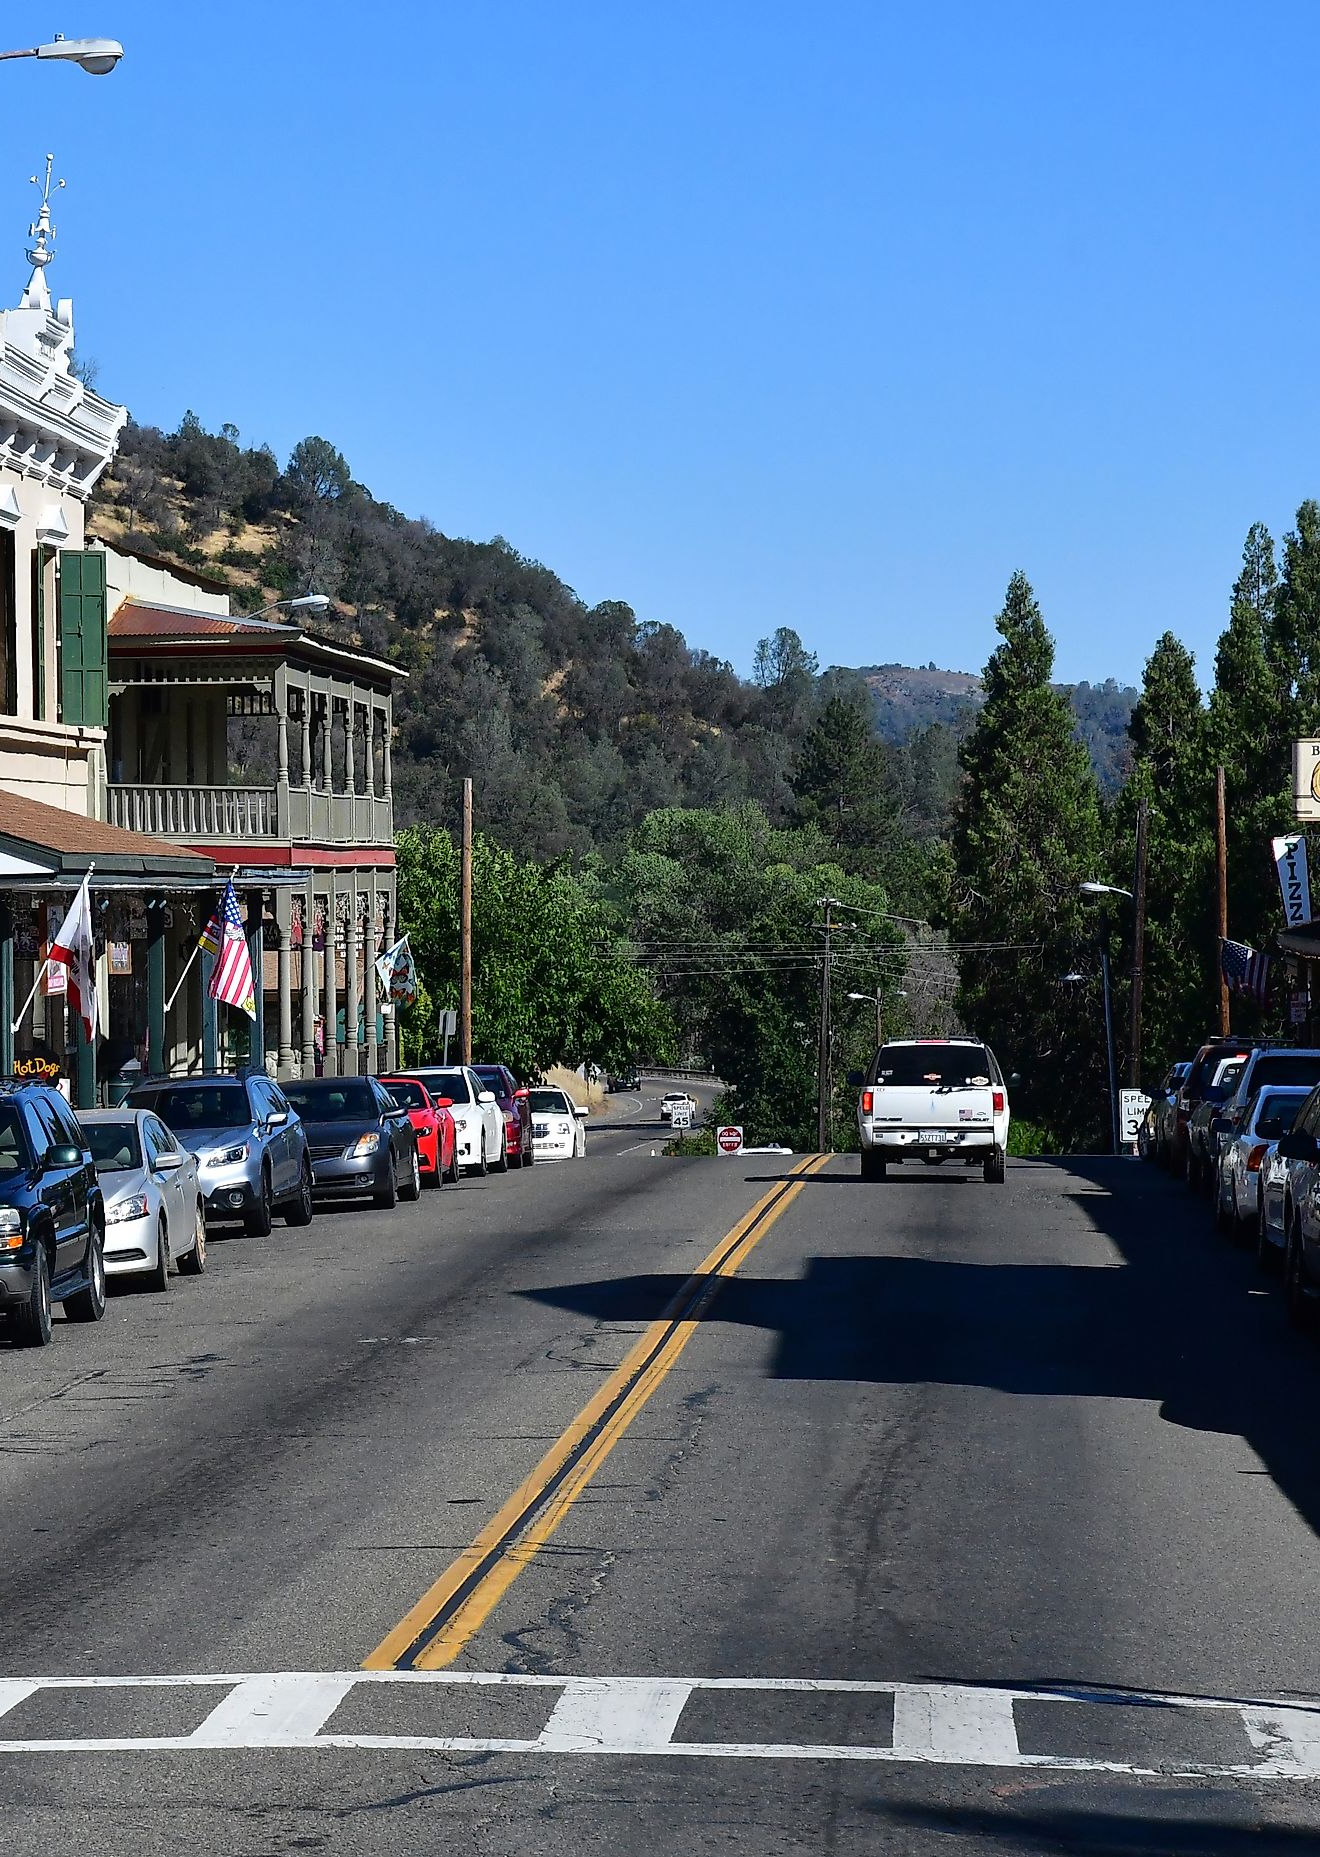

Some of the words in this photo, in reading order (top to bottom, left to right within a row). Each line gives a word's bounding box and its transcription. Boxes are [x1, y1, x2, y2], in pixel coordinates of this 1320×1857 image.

[1285, 842, 1304, 925] PIZZ
[13, 1059, 36, 1076] Hot
[34, 1057, 61, 1078] Dogs
[674, 1117, 688, 1125] 45
